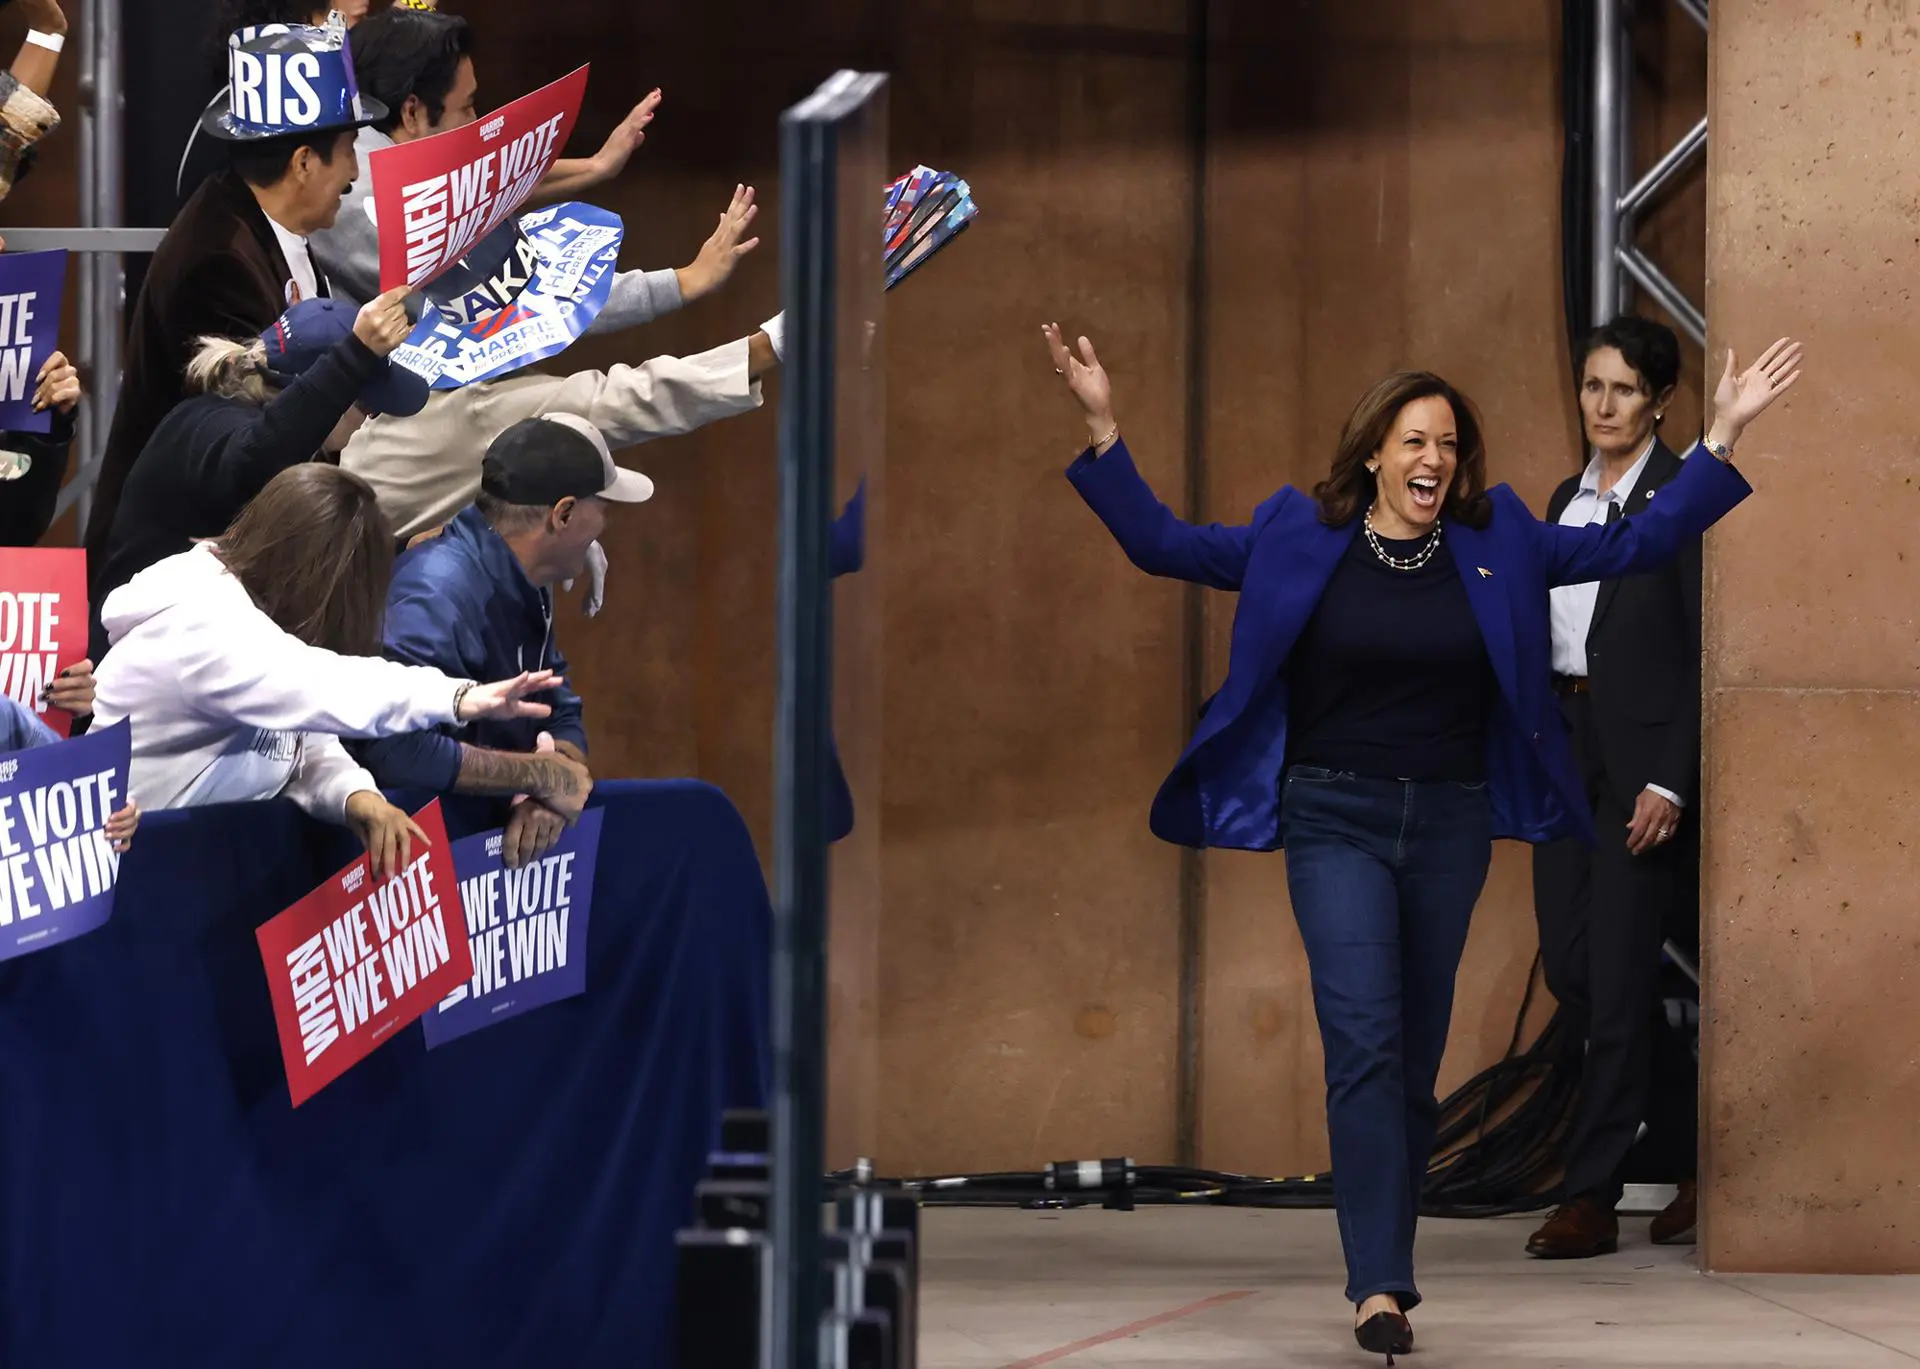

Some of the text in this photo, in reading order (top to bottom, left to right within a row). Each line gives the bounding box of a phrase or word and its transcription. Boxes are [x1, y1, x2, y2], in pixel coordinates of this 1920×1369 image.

[229, 48, 321, 126] RIS
[450, 112, 564, 219] WE VOTE
[402, 173, 448, 288] WHEN
[439, 198, 493, 268] WE
[545, 228, 602, 288] HARRIS
[391, 347, 448, 377] HARRIS
[468, 318, 557, 364] HARRIS
[19, 767, 118, 847] VOTE
[322, 851, 439, 977] WE VOTE
[460, 852, 575, 936] WE VOTE
[333, 905, 450, 1035] WE WIN
[468, 926, 506, 999] WE
[507, 907, 569, 983] WIN
[286, 932, 340, 1067] WHEN
